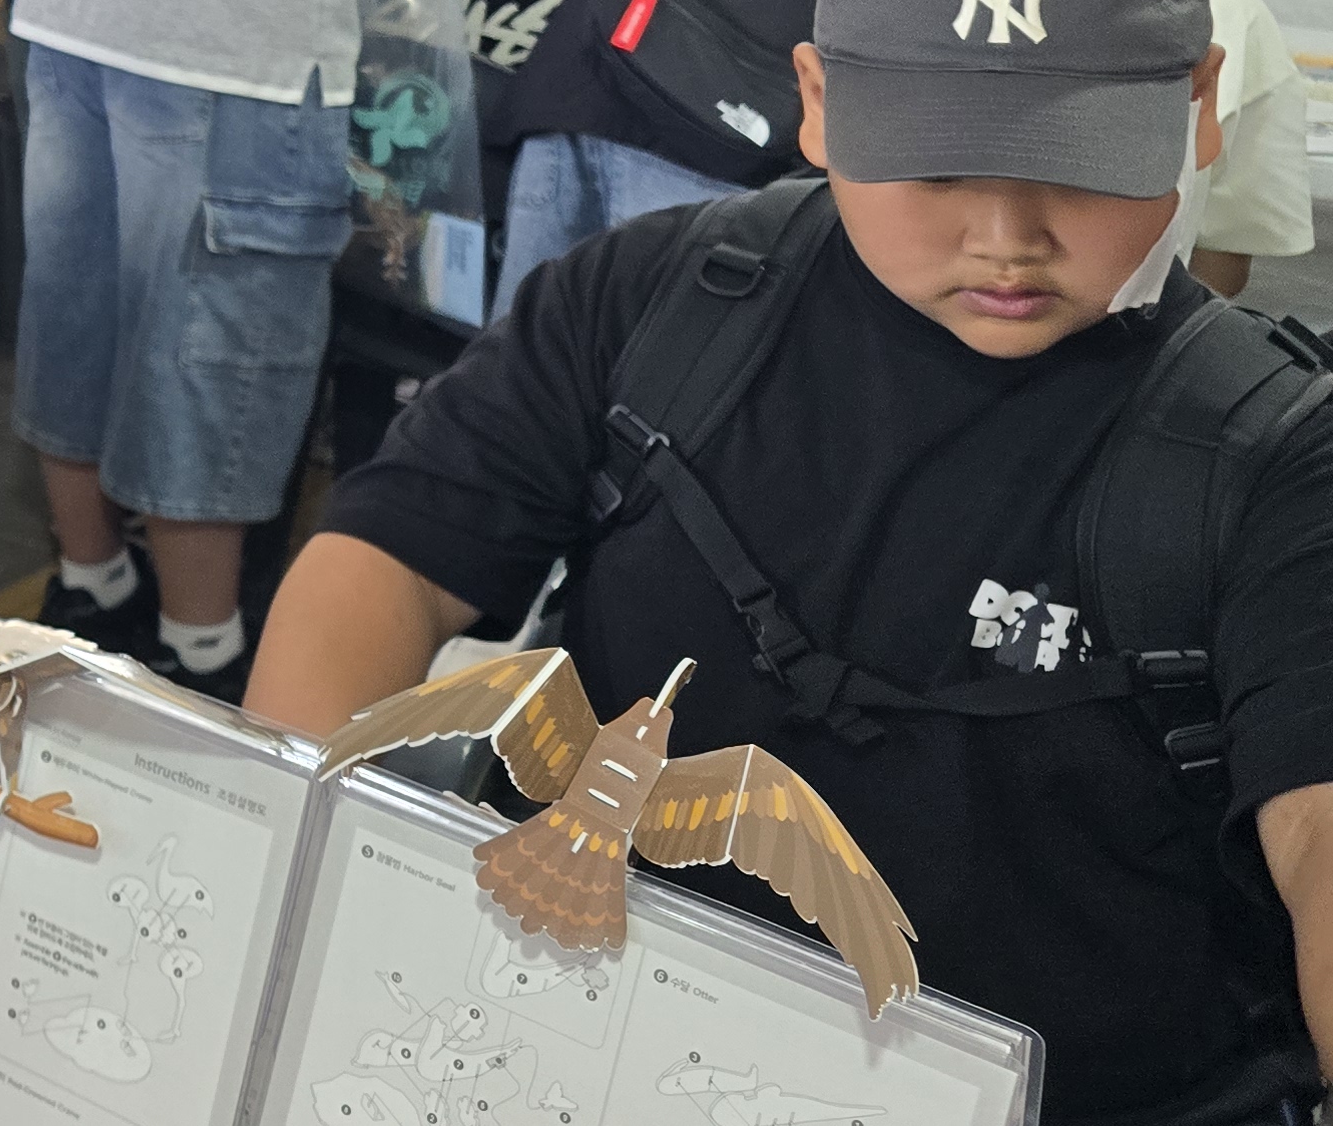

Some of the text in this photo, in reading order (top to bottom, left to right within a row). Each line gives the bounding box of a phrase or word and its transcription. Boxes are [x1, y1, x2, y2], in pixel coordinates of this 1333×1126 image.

[134, 752, 212, 796] Instructions
[403, 864, 434, 883] Harbor
[436, 877, 456, 892] Seal
[654, 968, 719, 1004] 6 수달 Otter
